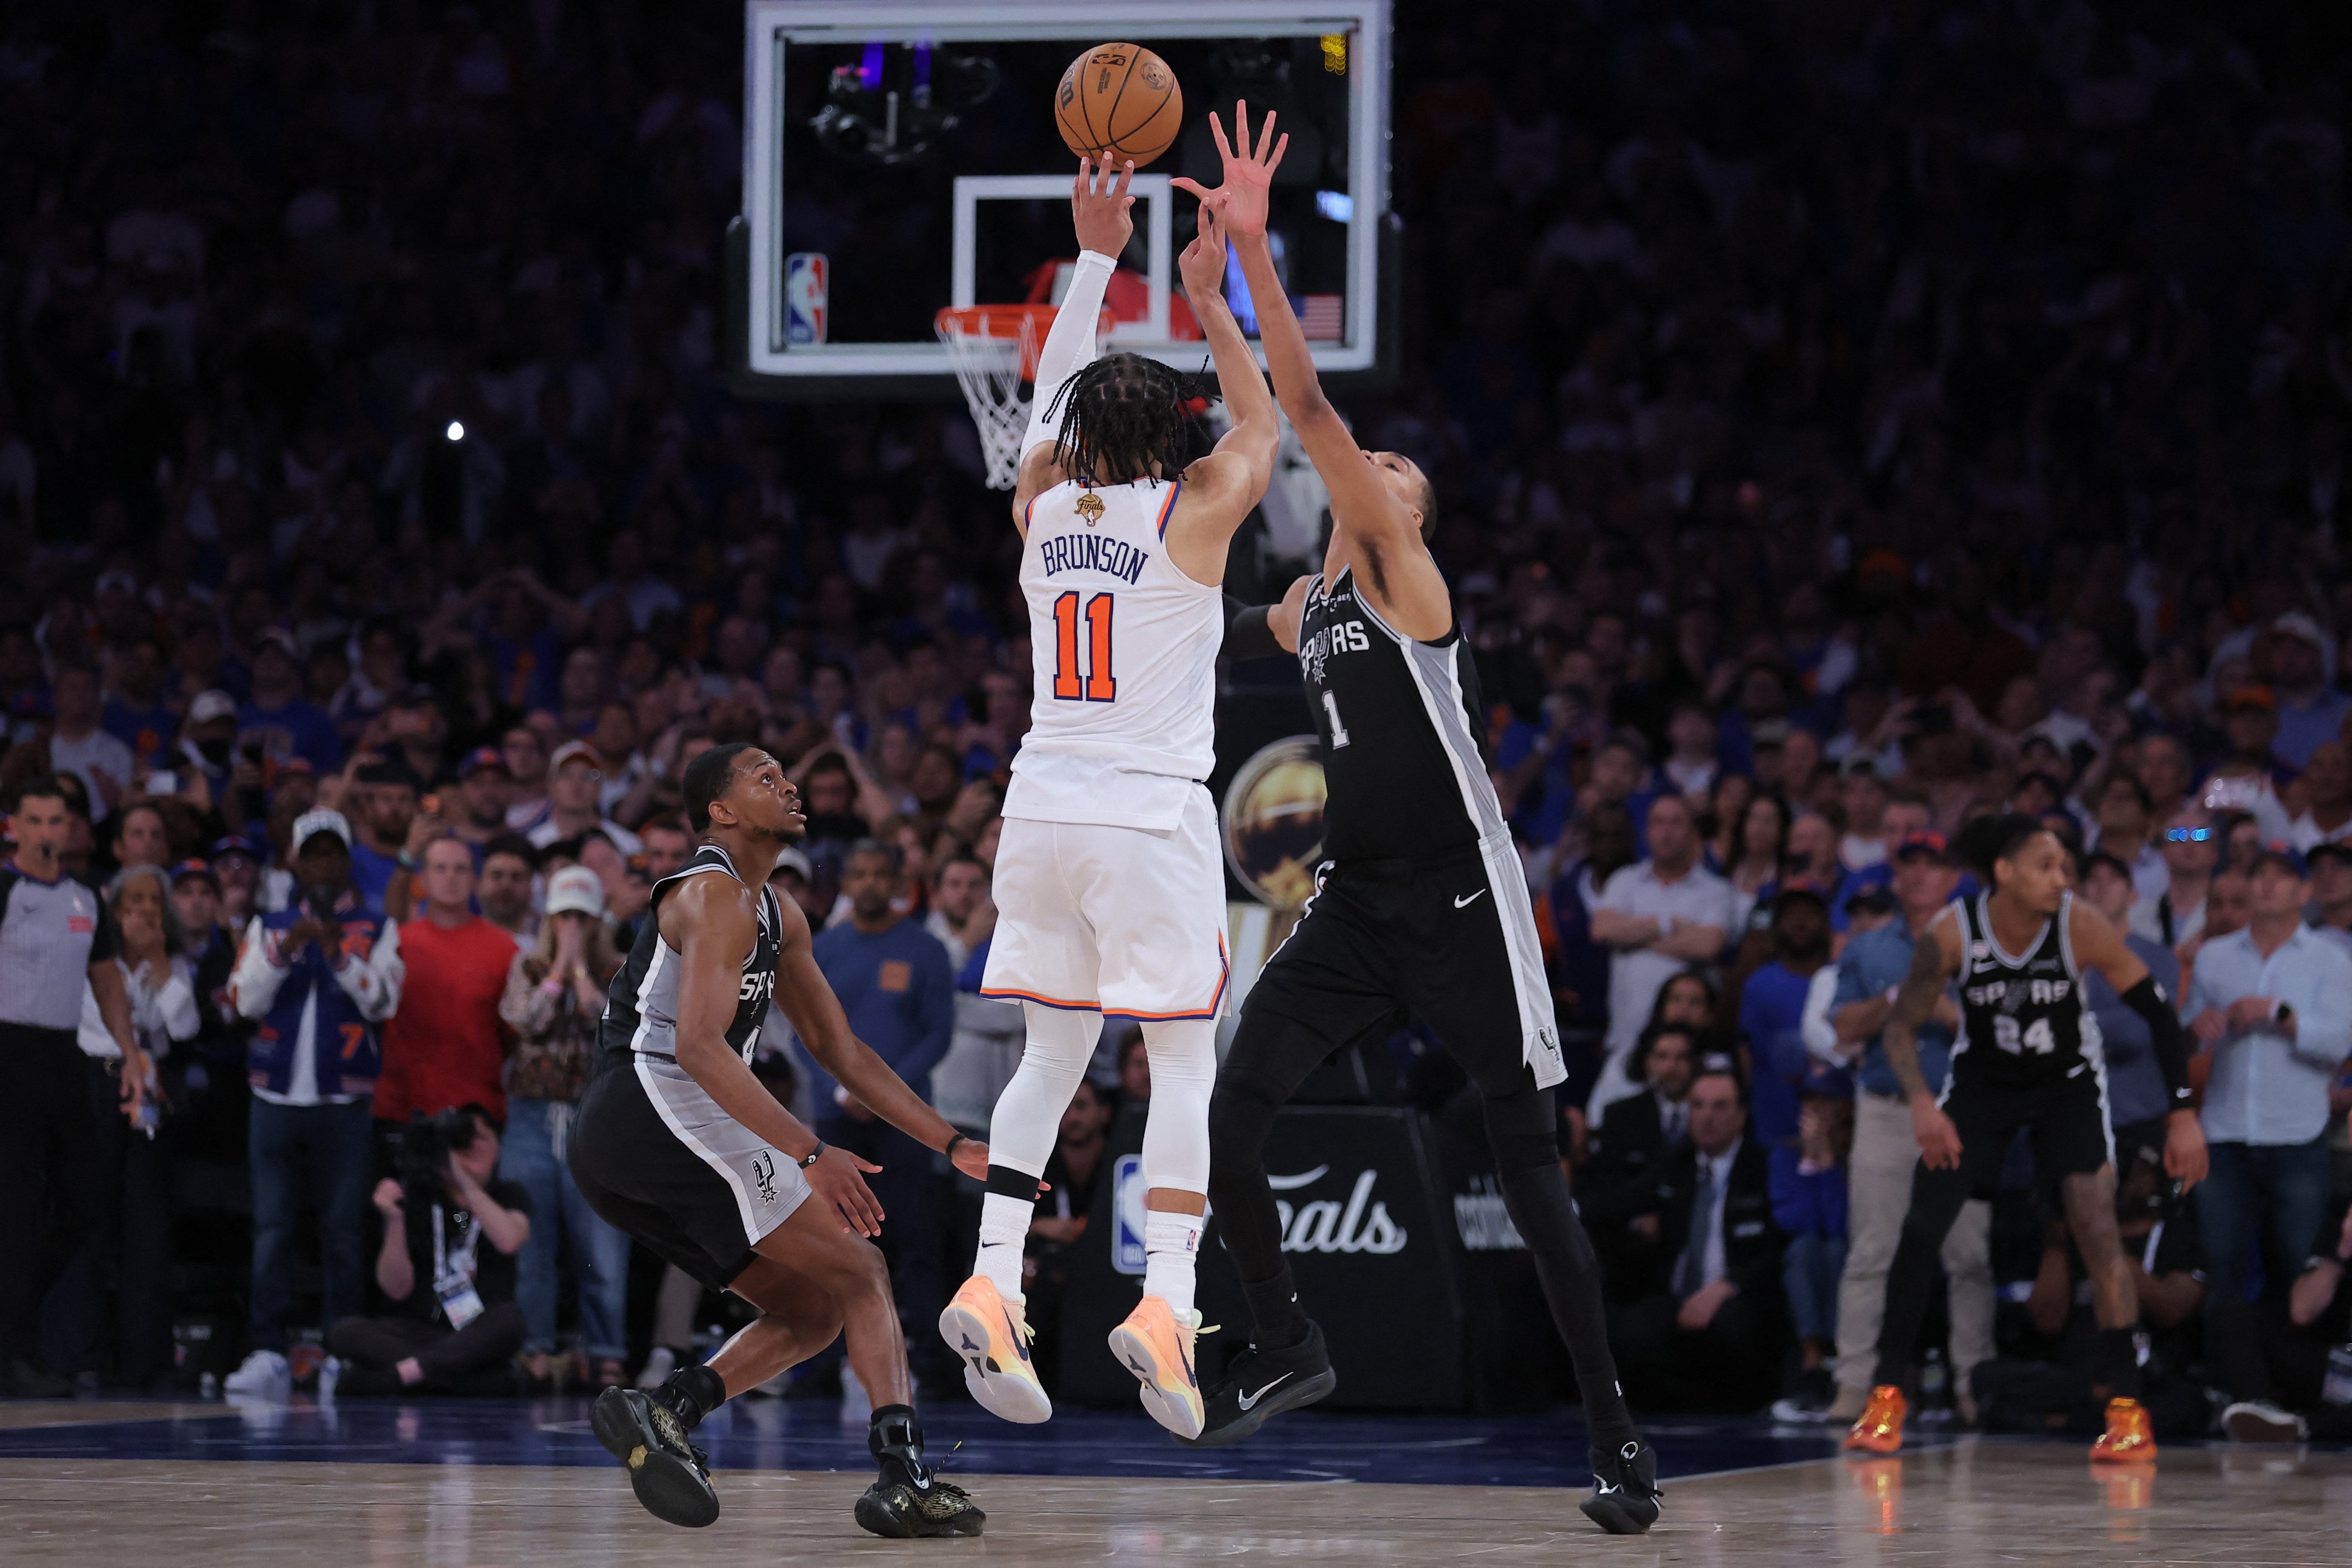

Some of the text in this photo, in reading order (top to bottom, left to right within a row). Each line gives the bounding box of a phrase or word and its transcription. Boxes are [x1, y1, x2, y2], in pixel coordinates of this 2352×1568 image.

[1076, 499, 1104, 513] Finals
[1041, 534, 1149, 585] BRUNSON
[1052, 590, 1116, 703] 11
[1321, 689, 1351, 749] 1
[339, 1023, 364, 1060] 7
[1992, 1014, 2055, 1055] 24
